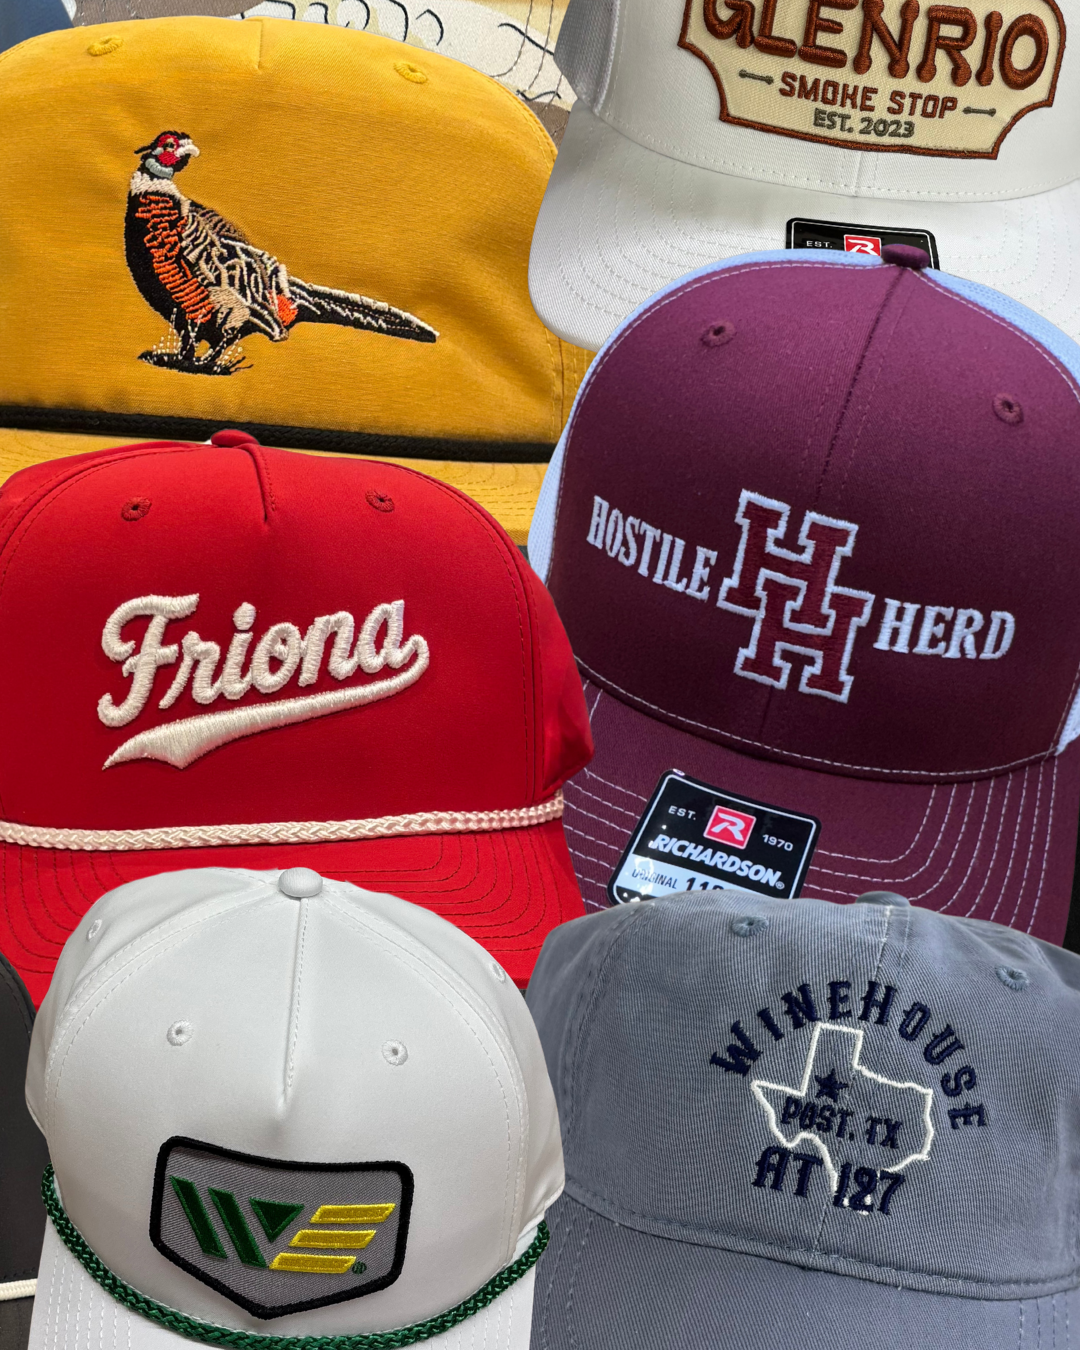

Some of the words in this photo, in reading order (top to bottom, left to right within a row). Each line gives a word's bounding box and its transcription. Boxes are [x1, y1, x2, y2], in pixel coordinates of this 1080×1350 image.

[778, 70, 879, 113] SMOKE
[887, 90, 958, 119] STOP
[813, 108, 853, 133] EST.
[860, 115, 915, 139] 2023
[806, 240, 833, 249] EST.
[586, 495, 718, 602] HOSTILE
[873, 597, 1016, 660] HERD
[98, 593, 429, 730] Friona
[668, 805, 696, 821] EST.
[762, 834, 794, 851] 1970
[710, 980, 988, 1130] WINEHOUSE
[866, 1116, 903, 1149] TX
[752, 1145, 824, 1198] AT
[833, 1161, 906, 1216] 127
